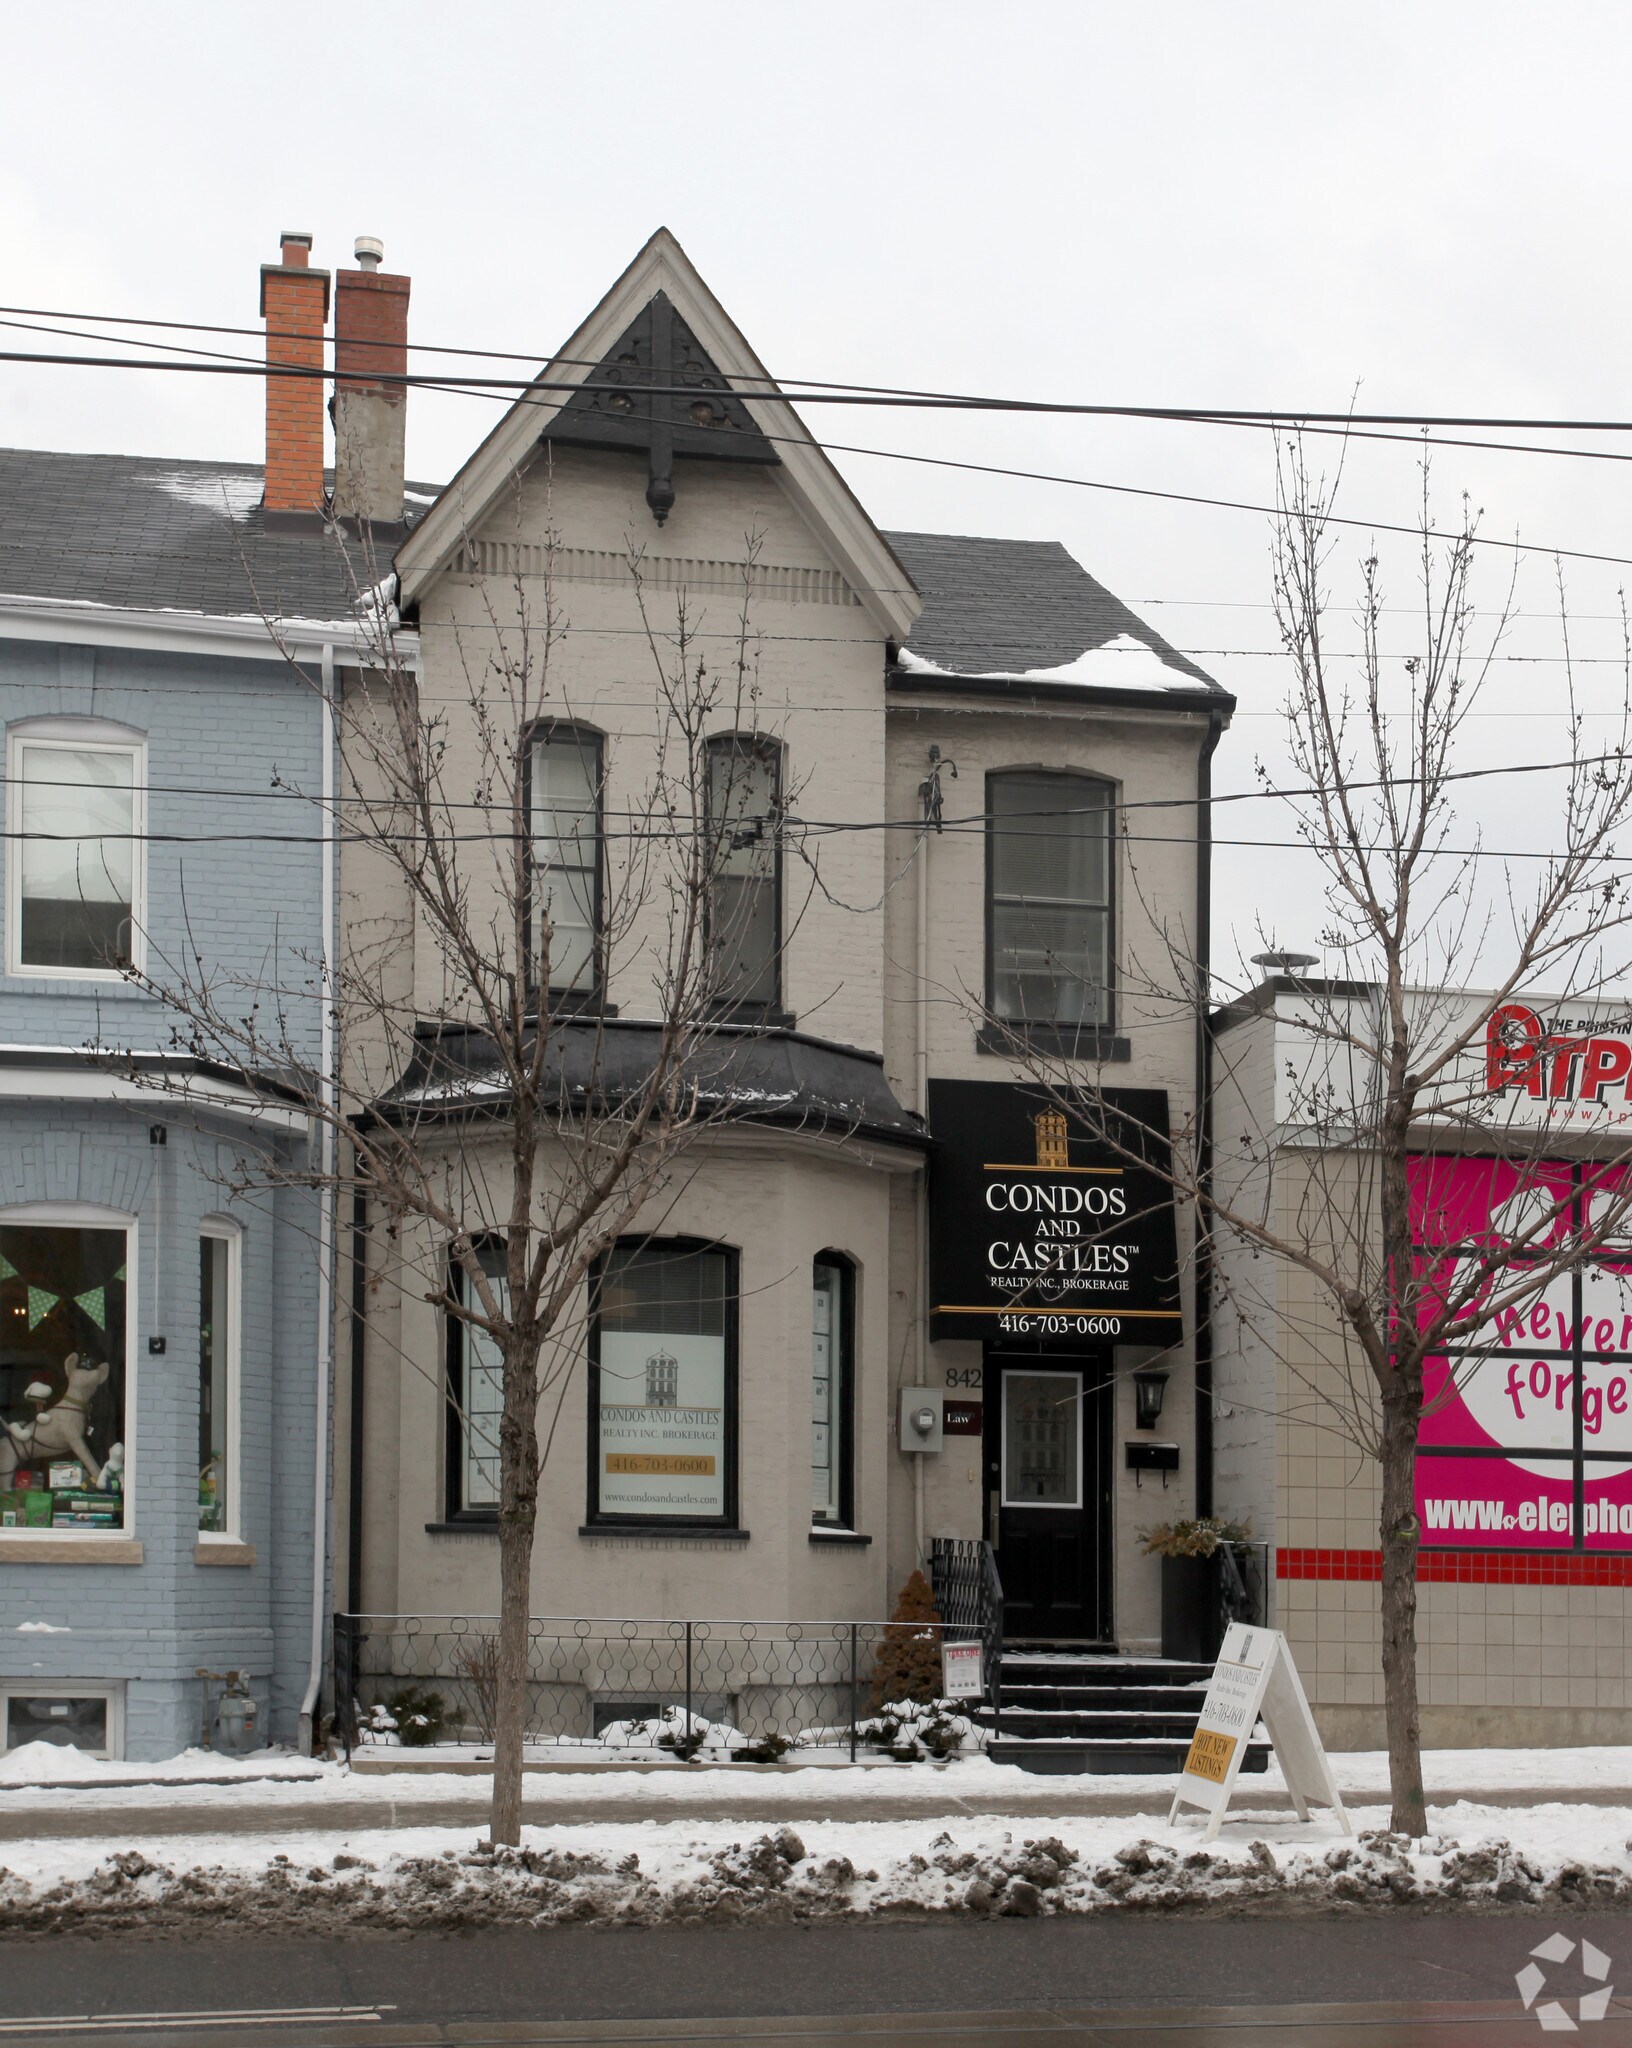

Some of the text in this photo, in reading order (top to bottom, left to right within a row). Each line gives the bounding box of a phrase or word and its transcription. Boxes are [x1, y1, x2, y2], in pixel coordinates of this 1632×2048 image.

[1547, 1018, 1575, 1031] THE
[985, 1183, 1127, 1215] CONDOS
[1035, 1219, 1081, 1237] AND
[991, 1276, 1032, 1288] REALTY
[1062, 1278, 1130, 1291] BROKERAGE
[999, 1314, 1121, 1335] 416-703-0600
[945, 1368, 982, 1388] 842
[1504, 1360, 1632, 1435] forge
[600, 1408, 719, 1425] CONDOS AND CASTLES
[947, 1412, 969, 1423] Law
[603, 1428, 638, 1438] REALTY
[662, 1430, 718, 1440] BROKERAGE
[613, 1457, 708, 1473] 416-703-0600
[604, 1491, 718, 1505] www.condosandcastles.com
[1194, 1733, 1231, 1756] HOT NEW
[1189, 1752, 1224, 1778] LISTINGS
